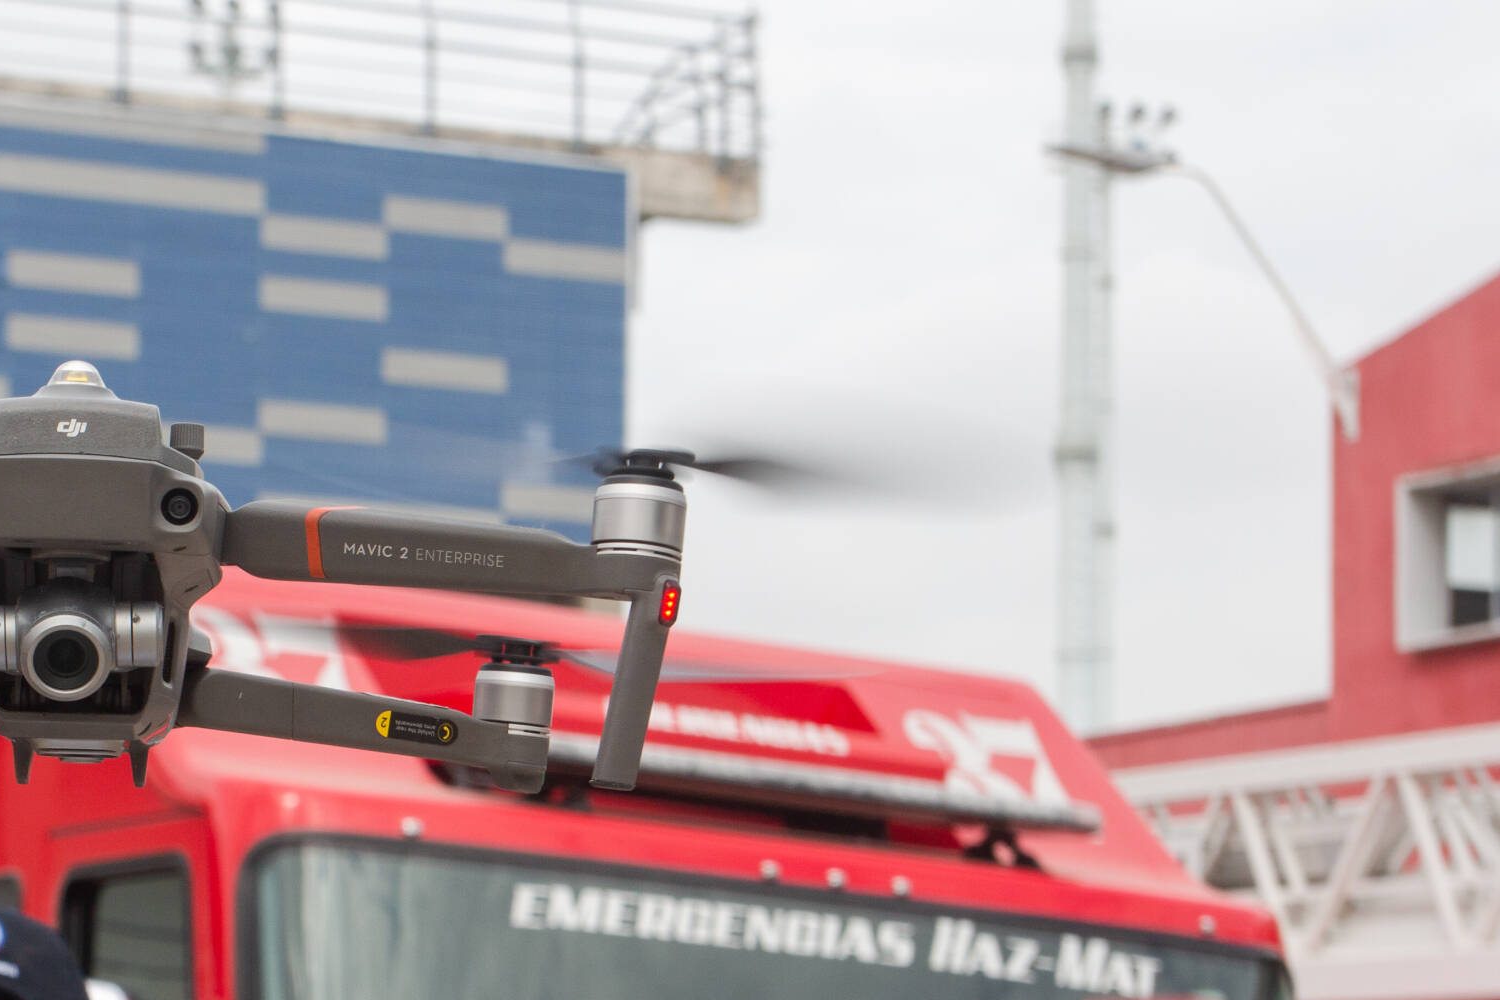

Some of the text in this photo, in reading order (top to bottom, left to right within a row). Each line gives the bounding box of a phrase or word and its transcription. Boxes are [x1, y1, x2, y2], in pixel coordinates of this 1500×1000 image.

[343, 542, 505, 568] MAVIC 2 ENTERPRISE
[380, 717, 388, 728] 2
[903, 708, 1074, 808] 27
